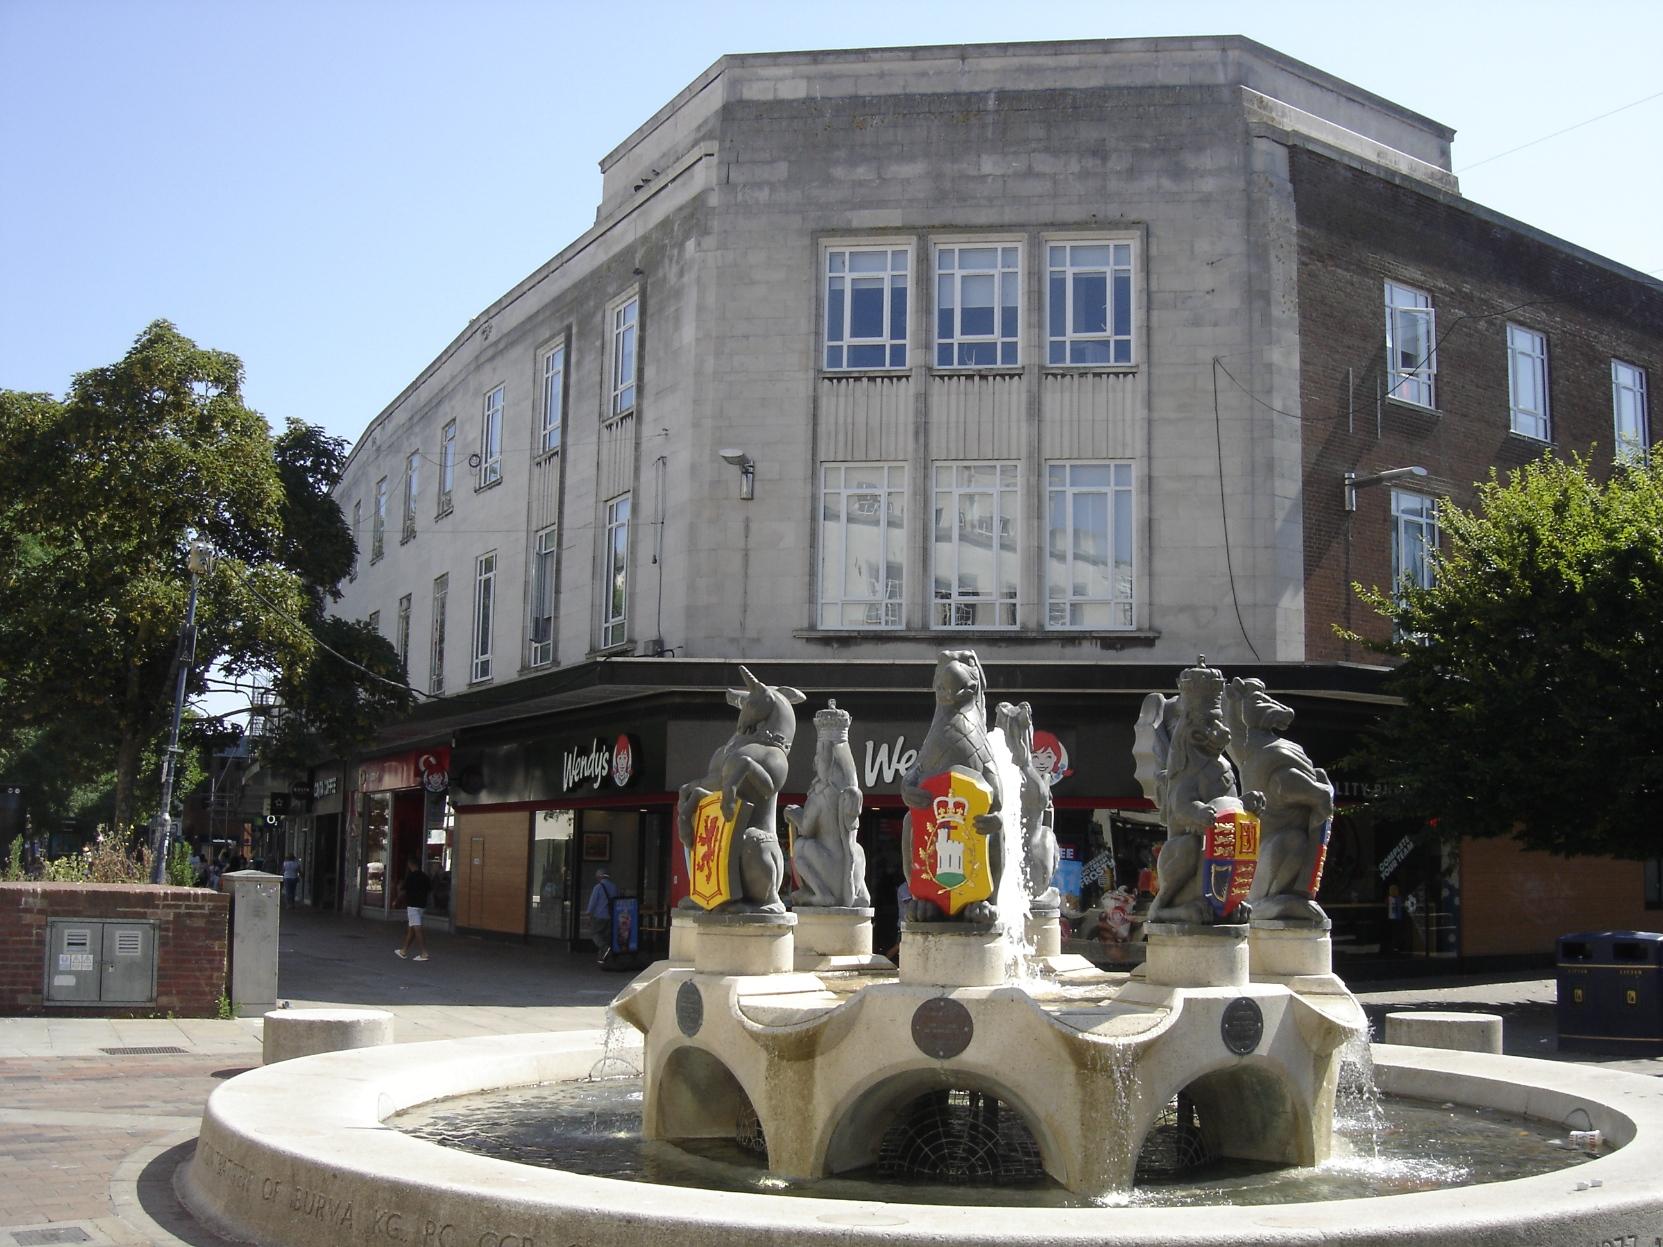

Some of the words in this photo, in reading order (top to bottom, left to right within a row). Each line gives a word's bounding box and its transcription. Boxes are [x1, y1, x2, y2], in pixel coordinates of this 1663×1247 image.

[563, 737, 609, 792] Wendy's
[1335, 782, 1368, 797] LITY
[1059, 847, 1074, 859] EE
[1379, 834, 1411, 872] COMPLETE
[1380, 859, 1399, 881] YOUR
[1396, 841, 1415, 863] TEAM
[1080, 858, 1115, 889] FROSTY
[261, 1177, 282, 1203] OF
[291, 1185, 354, 1231] BURMA
